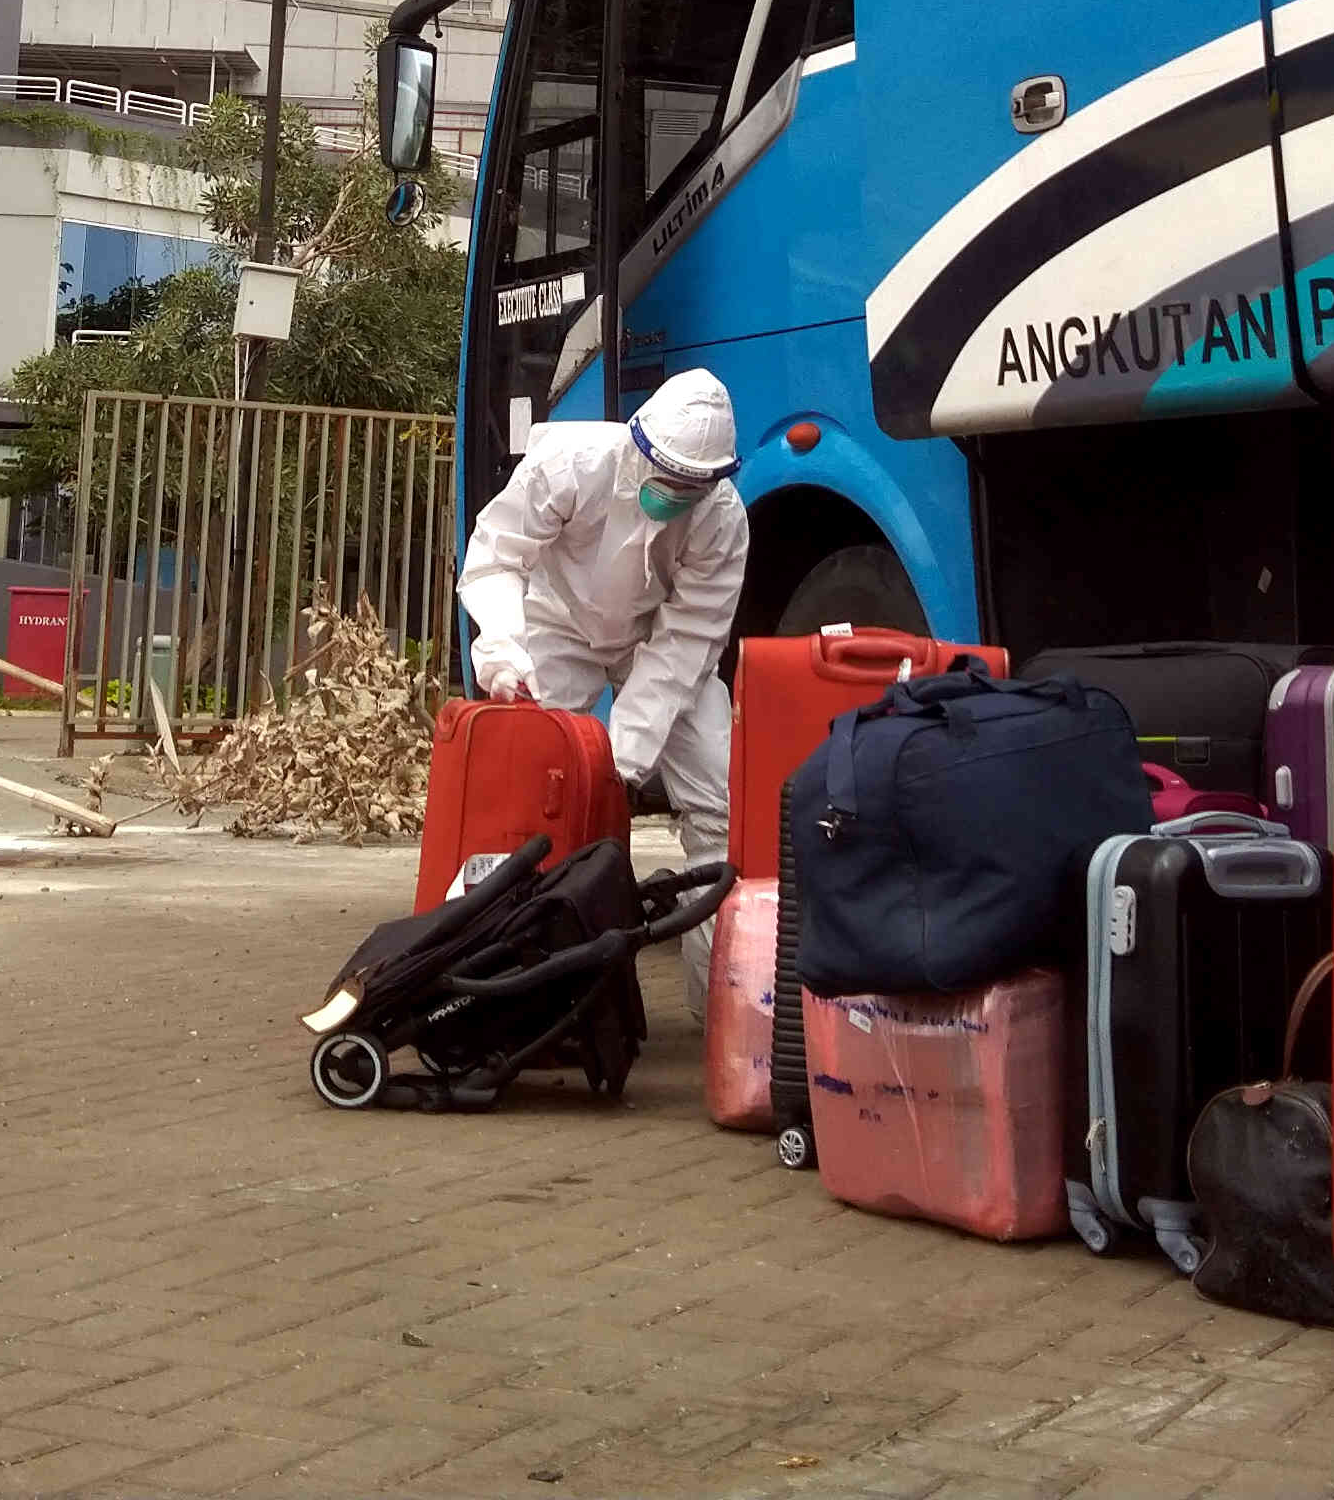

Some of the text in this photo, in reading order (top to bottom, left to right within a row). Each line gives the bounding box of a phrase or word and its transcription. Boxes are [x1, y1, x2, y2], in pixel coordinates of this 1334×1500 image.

[498, 279, 562, 326] EXECUTIVE CLASS
[997, 292, 1277, 386] ANGKUTAN
[18, 614, 68, 627] HYDRAN
